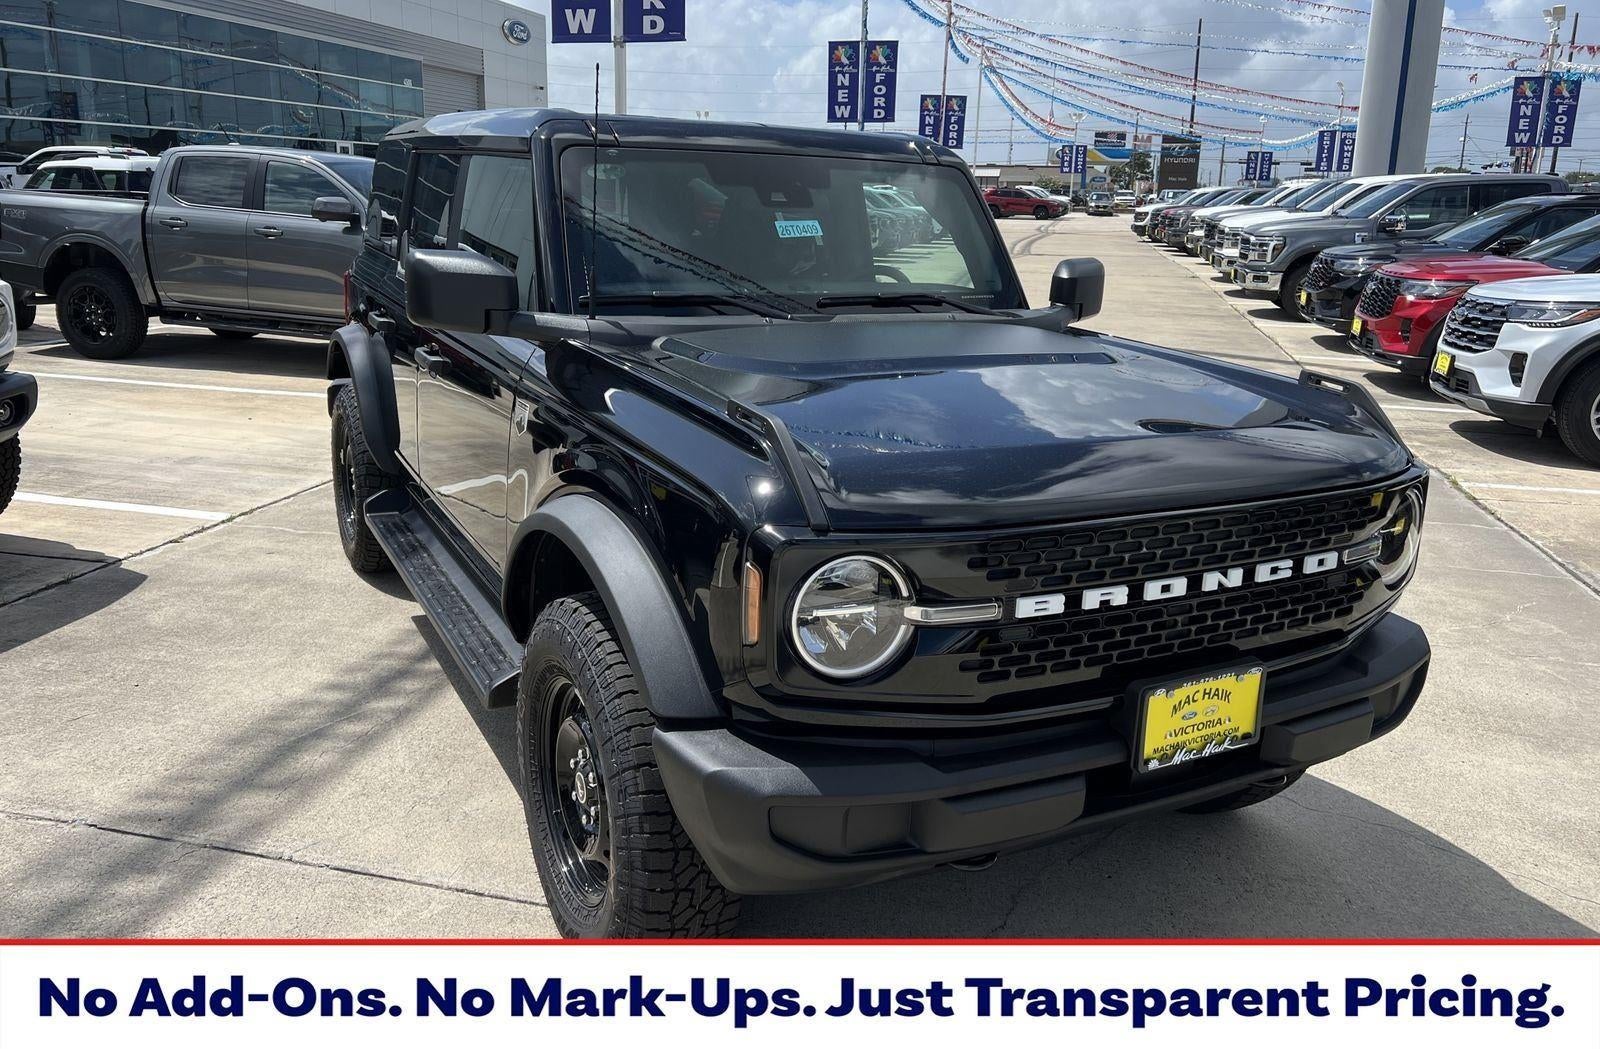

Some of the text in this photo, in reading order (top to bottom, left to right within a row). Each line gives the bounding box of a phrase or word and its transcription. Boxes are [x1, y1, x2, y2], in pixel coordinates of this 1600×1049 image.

[834, 73, 851, 119] NEW
[873, 73, 887, 119] FORD
[948, 116, 958, 147] FORD
[1514, 104, 1533, 144] NEW
[1551, 105, 1569, 144] FORD
[1062, 156, 1070, 173] NEW
[1320, 131, 1330, 171] CERTIFIED
[1342, 139, 1353, 170] OWNED
[1247, 162, 1256, 179] NEW
[778, 224, 819, 236] 26T0409
[1014, 550, 1339, 619] BRONCO
[1171, 690, 1200, 718] MAC
[1202, 687, 1232, 704] HAIK
[1152, 726, 1240, 755] MACHAIKVICTORIA.COM
[1172, 717, 1223, 739] VICTORIA
[1171, 747, 1200, 766] Mac
